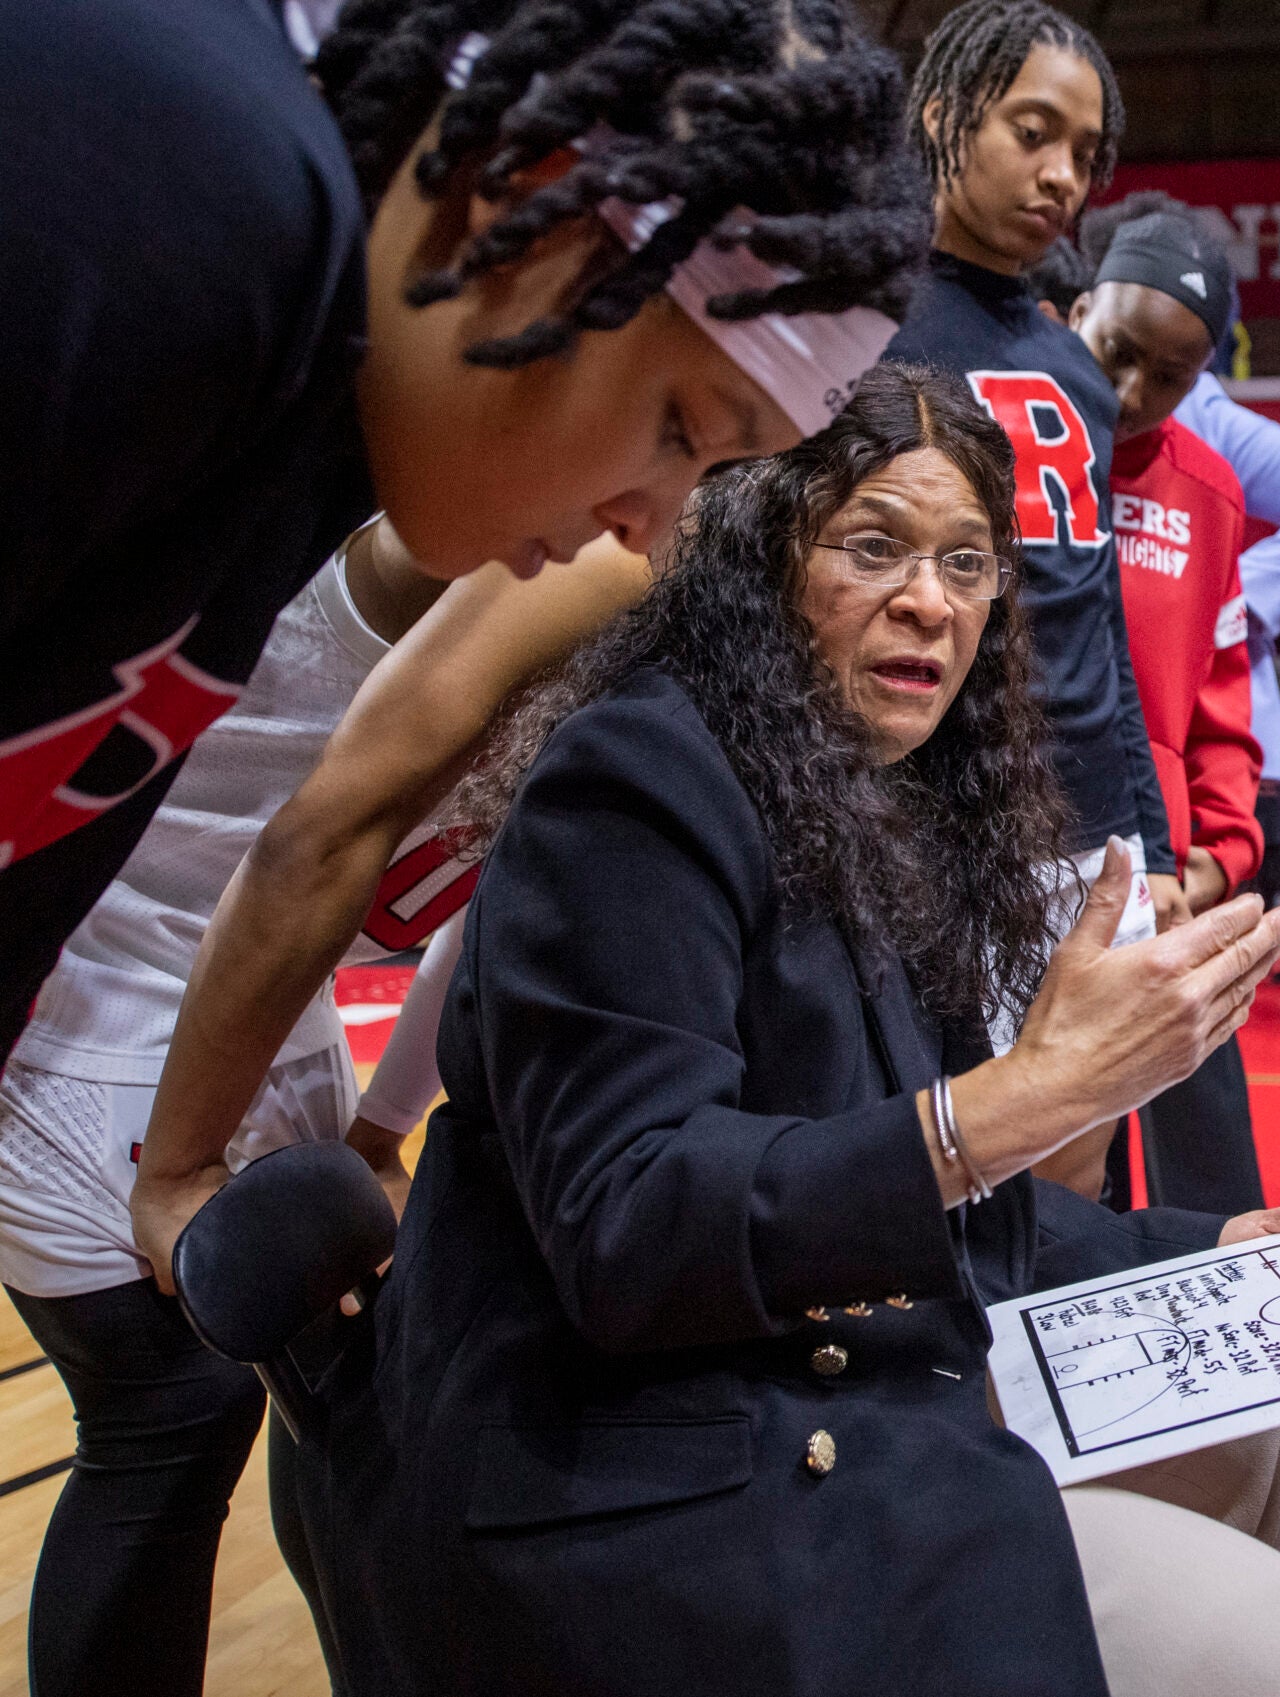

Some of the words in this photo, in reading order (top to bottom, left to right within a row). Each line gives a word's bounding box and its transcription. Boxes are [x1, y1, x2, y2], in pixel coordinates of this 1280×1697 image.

[965, 369, 1113, 549] R
[1036, 1312, 1055, 1320] 3
[1156, 1334, 1181, 1347] FT
[1187, 1328, 1210, 1341] FT
[1228, 1348, 1251, 1363] 32
